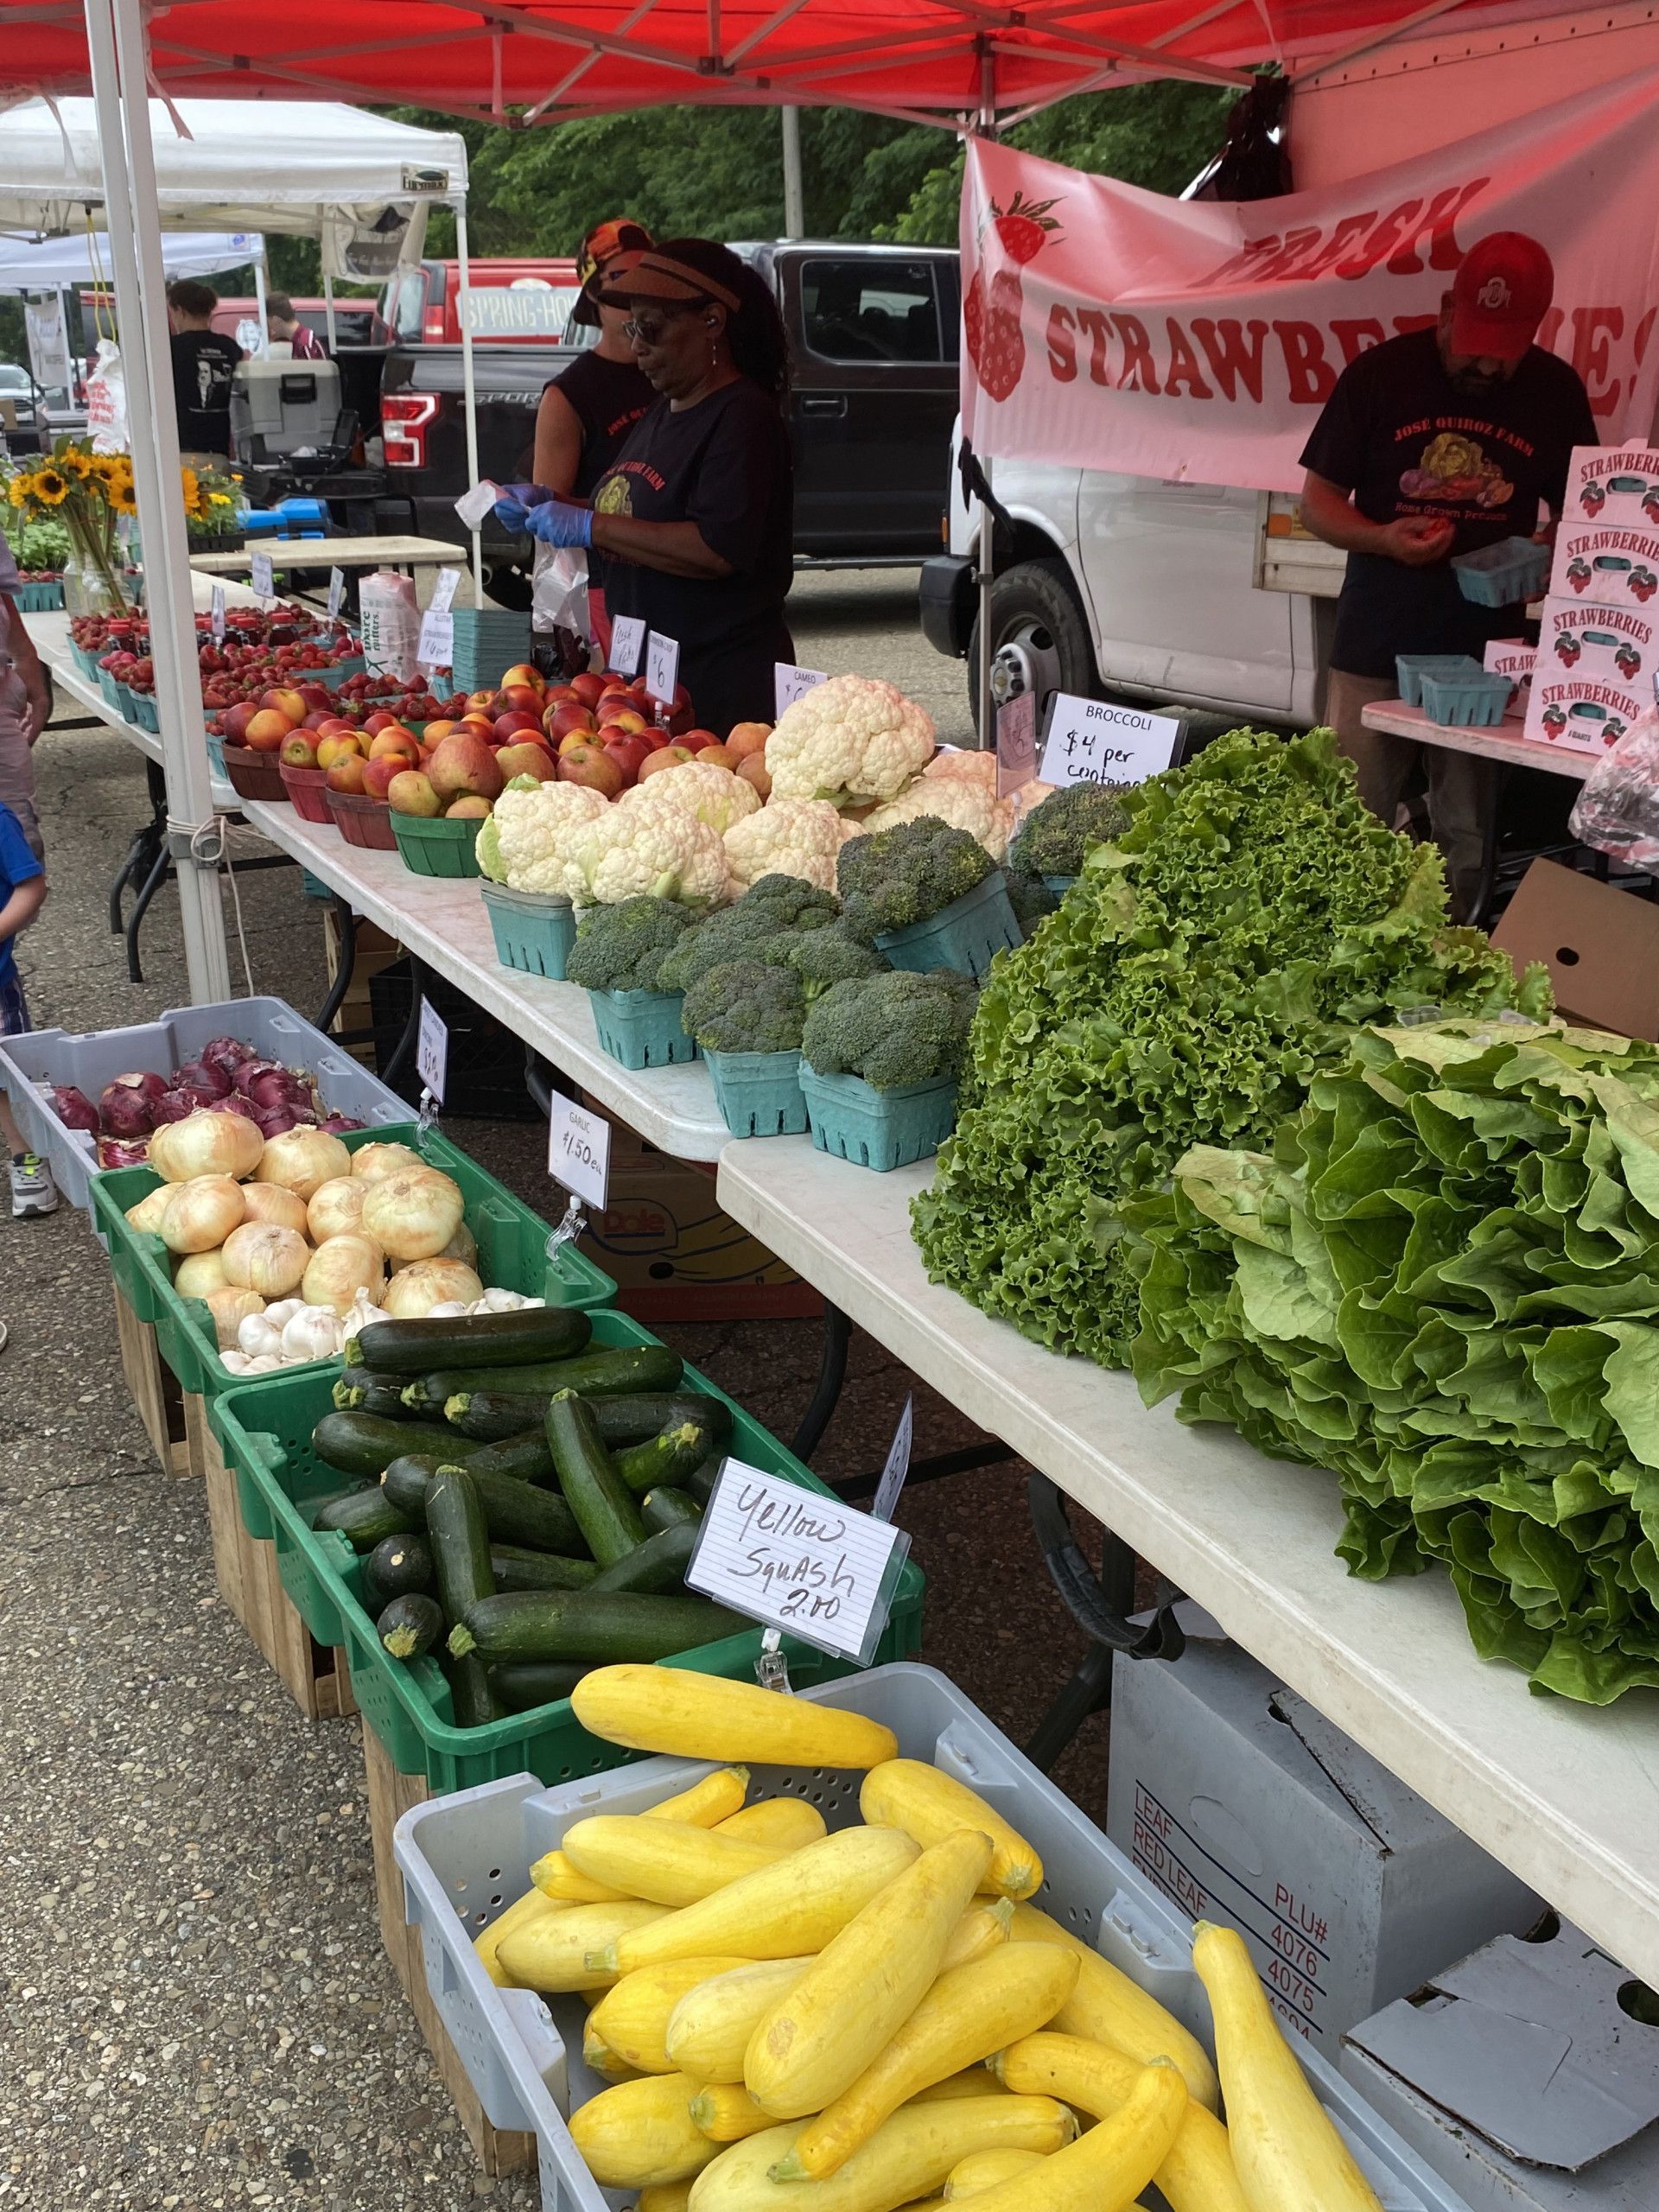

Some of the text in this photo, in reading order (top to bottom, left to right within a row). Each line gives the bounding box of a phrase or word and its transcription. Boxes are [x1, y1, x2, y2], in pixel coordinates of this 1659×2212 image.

[1187, 177, 1491, 288] FRESH
[469, 295, 572, 328] SPRING-HO
[1046, 302, 1658, 418] STRAWBEE
[1435, 416, 1494, 435] QUIROZ
[1495, 427, 1535, 457] FARM
[1554, 607, 1652, 645] STRAWBERRIES
[794, 671, 817, 684] CAMEO
[1085, 704, 1153, 732] BROCCOLI
[1541, 682, 1640, 721] STRAWBERRIES
[1059, 729, 1135, 768] $4 per
[569, 1111, 590, 1134] GARLIC
[604, 1209, 665, 1233] Dole
[737, 1484, 846, 1543] Yellow
[779, 1588, 841, 1620] 2.00
[1134, 1787, 1173, 1839] LEAF
[1134, 1820, 1165, 1871] RED
[1167, 1859, 1208, 1915] LEAF
[1275, 1882, 1329, 1945] PLU#
[1271, 1923, 1319, 1978] 4076
[1267, 1959, 1315, 2012] 4075
